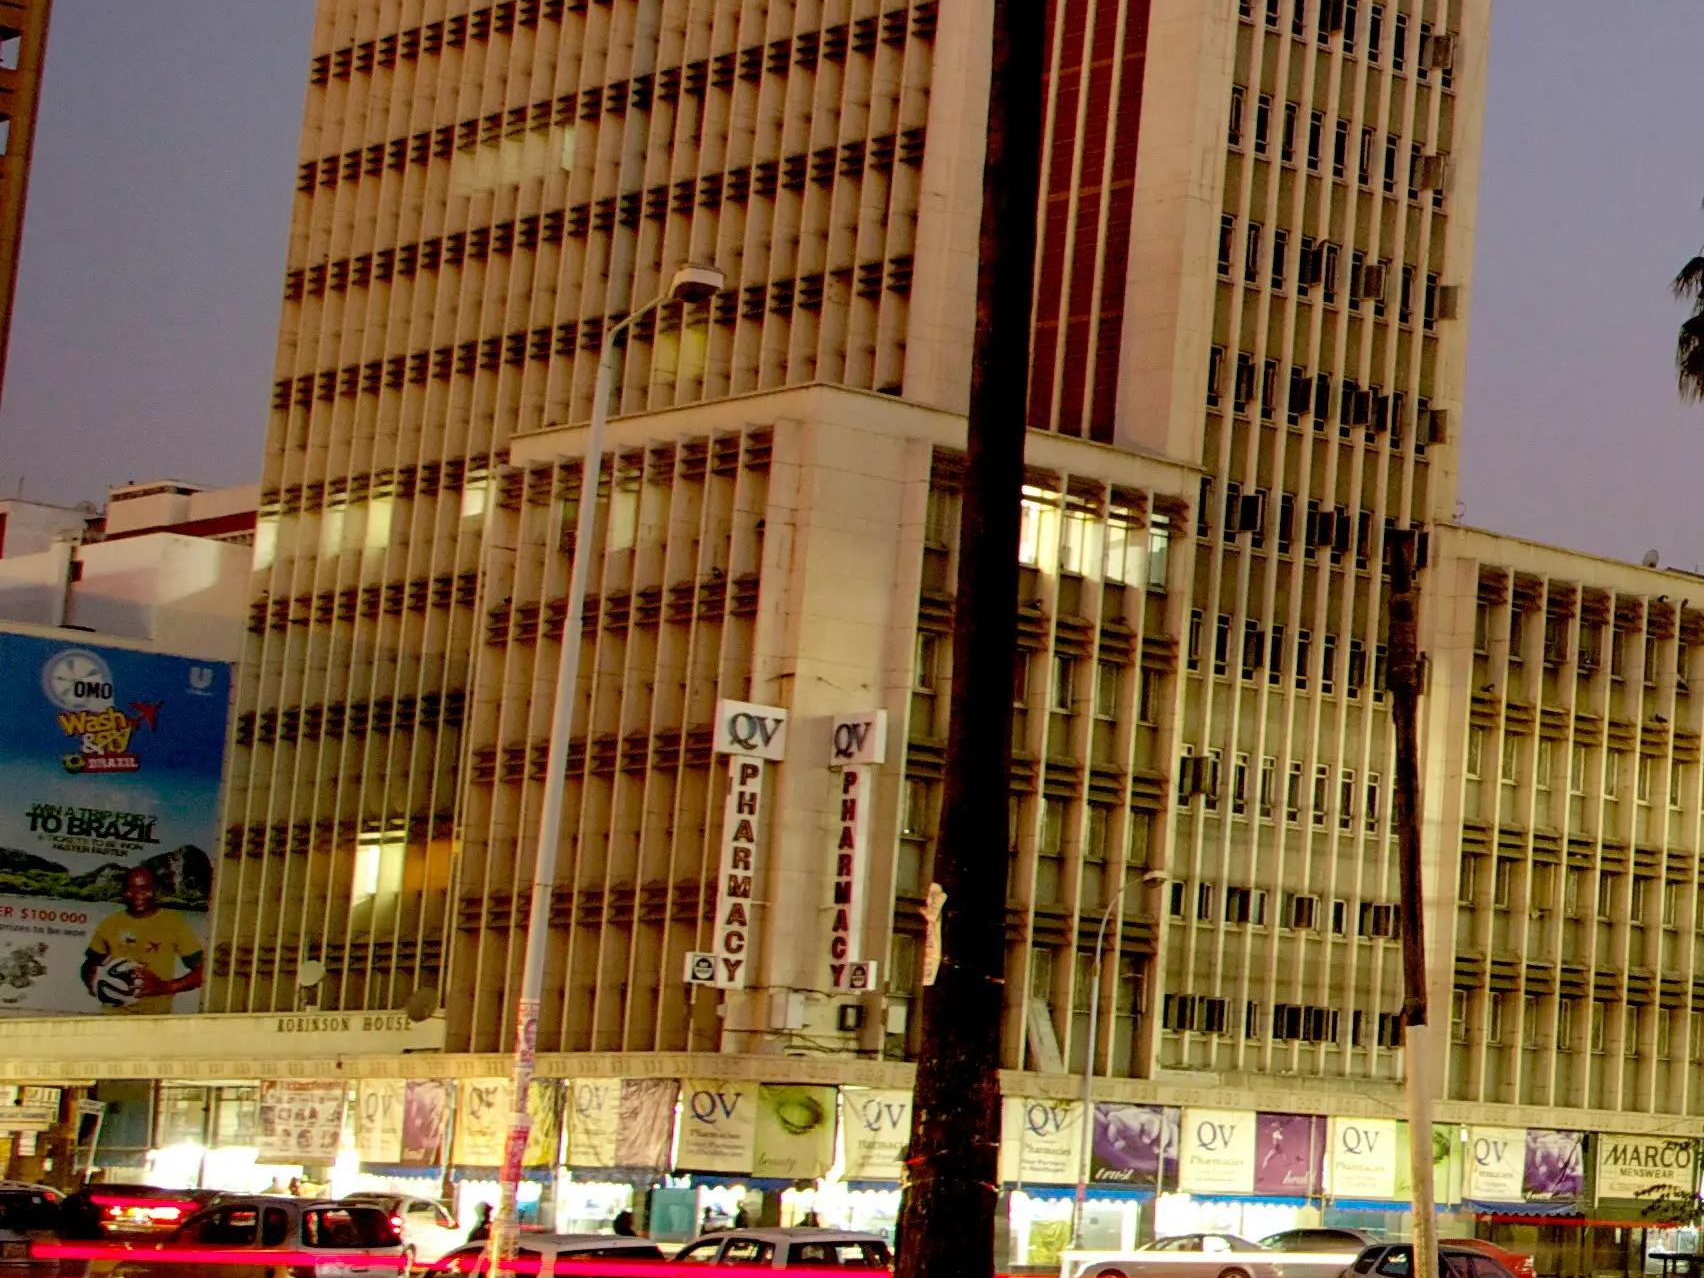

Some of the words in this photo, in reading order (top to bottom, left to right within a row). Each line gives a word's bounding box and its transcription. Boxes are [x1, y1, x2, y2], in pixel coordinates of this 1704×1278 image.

[74, 680, 113, 699] OMO
[58, 706, 128, 736] Wash
[727, 712, 784, 750] QV
[833, 722, 872, 759] QV
[87, 756, 139, 770] BRAZIL
[26, 811, 62, 834] TO
[66, 816, 160, 844] BRAZIL
[721, 763, 760, 983] PHARMACY
[830, 770, 858, 989] PHARMACY
[277, 1017, 350, 1033] ROBINSON
[362, 1016, 413, 1032] HOUSE
[690, 1089, 744, 1124] QV
[861, 1098, 908, 1132] QV
[1026, 1103, 1070, 1138] QV
[1196, 1120, 1237, 1152] QV
[1342, 1126, 1381, 1155] QV
[1473, 1137, 1509, 1166] QV
[1603, 1143, 1691, 1169] MARCO
[1620, 1167, 1675, 1179] MENSWEAR
